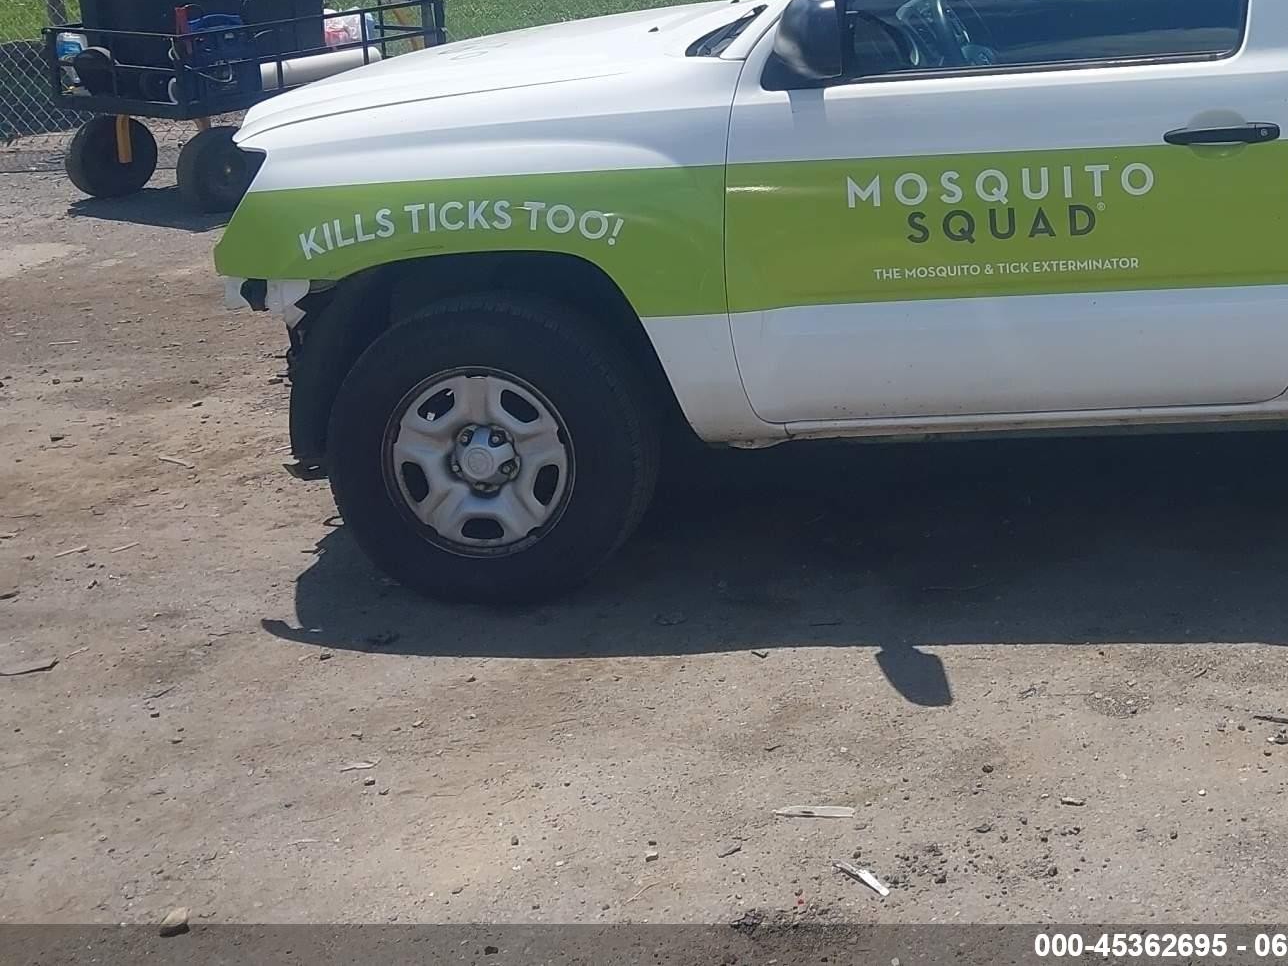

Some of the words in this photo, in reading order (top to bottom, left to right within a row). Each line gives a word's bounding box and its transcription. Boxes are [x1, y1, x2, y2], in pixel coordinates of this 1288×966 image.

[846, 162, 1154, 208] MOSQUITO
[298, 207, 395, 261] KILLS
[404, 200, 512, 233] TICKS
[524, 201, 625, 246] TOO!
[874, 268, 901, 280] THE
[905, 264, 981, 279] MOSQUITO
[984, 263, 994, 275] &
[997, 261, 1029, 274] TICK
[1033, 257, 1140, 273] EXTERMINATOR
